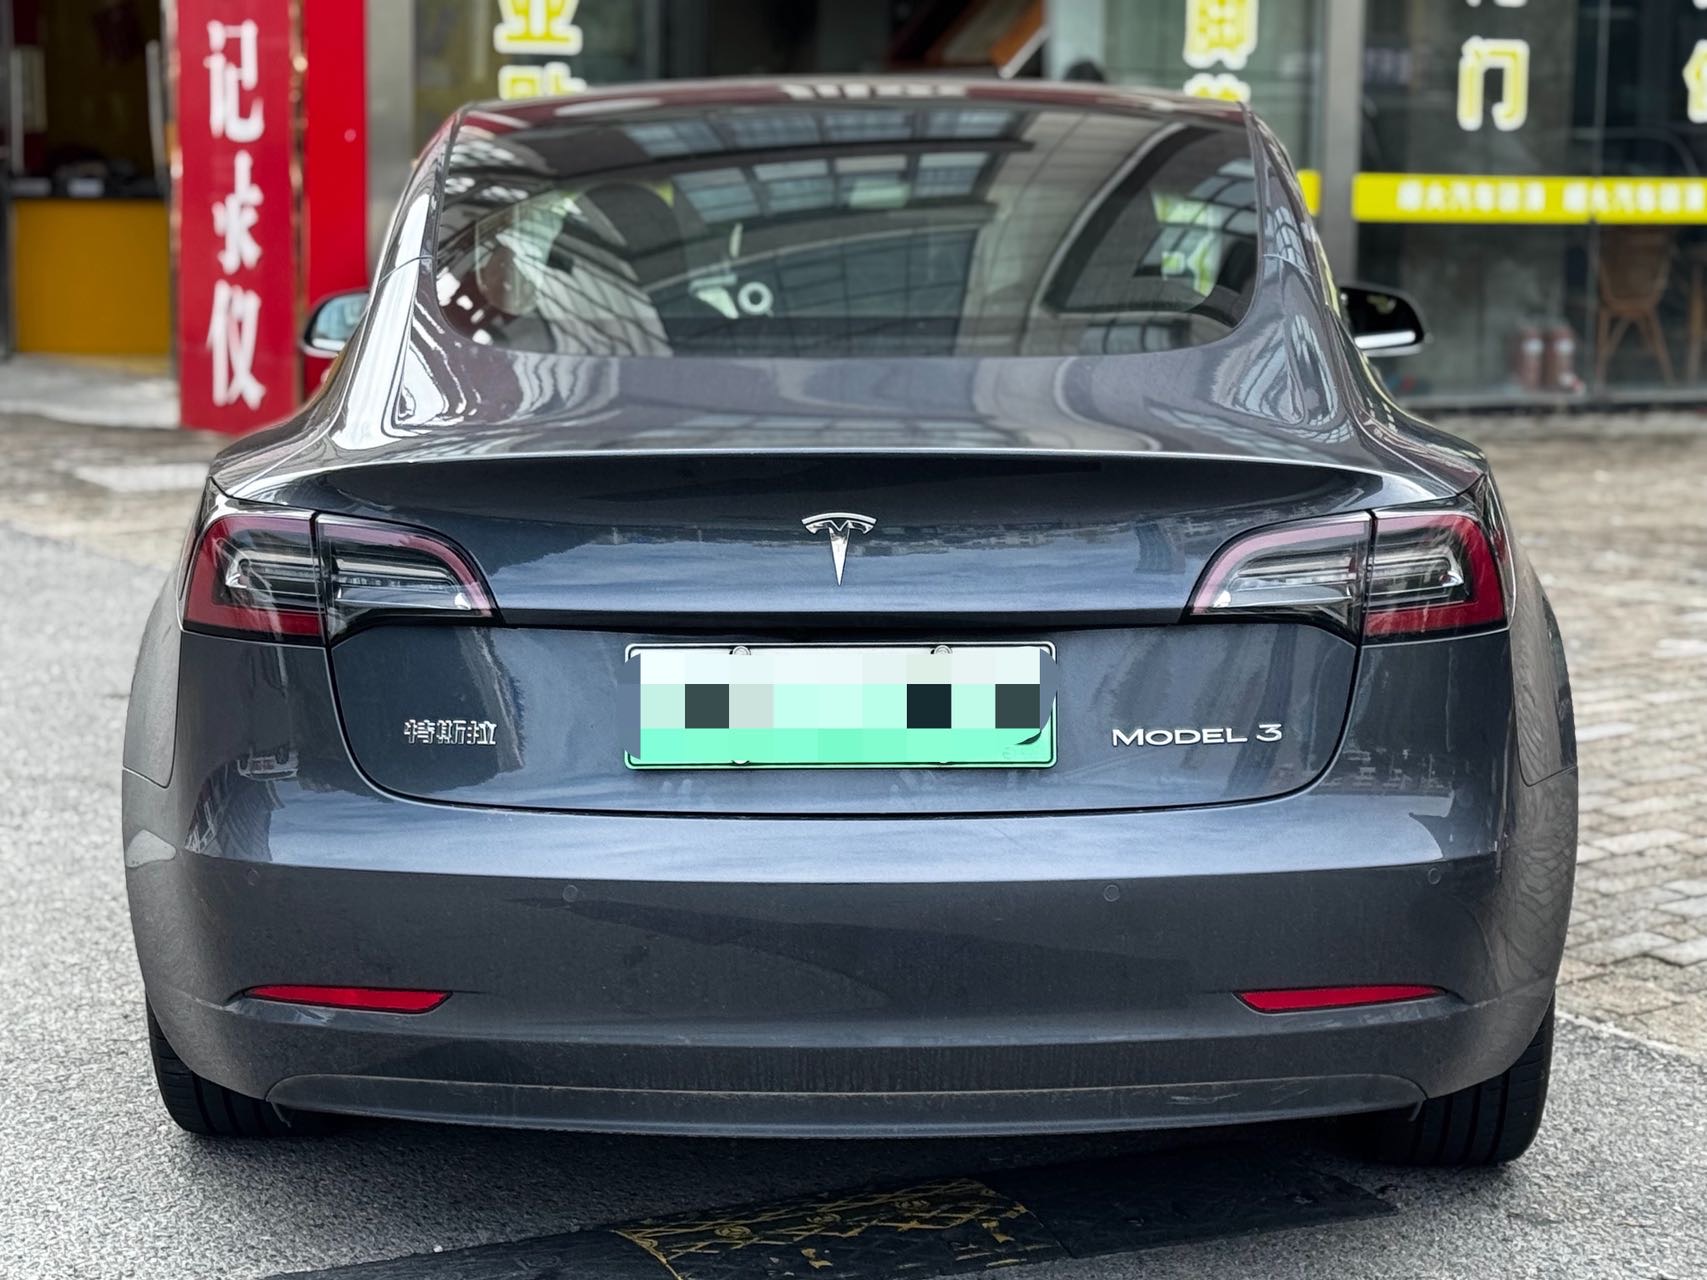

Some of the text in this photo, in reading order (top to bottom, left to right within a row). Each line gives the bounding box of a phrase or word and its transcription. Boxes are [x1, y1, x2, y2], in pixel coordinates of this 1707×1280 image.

[403, 718, 497, 745] 特斯拉
[1112, 723, 1283, 747] MODEL 3
